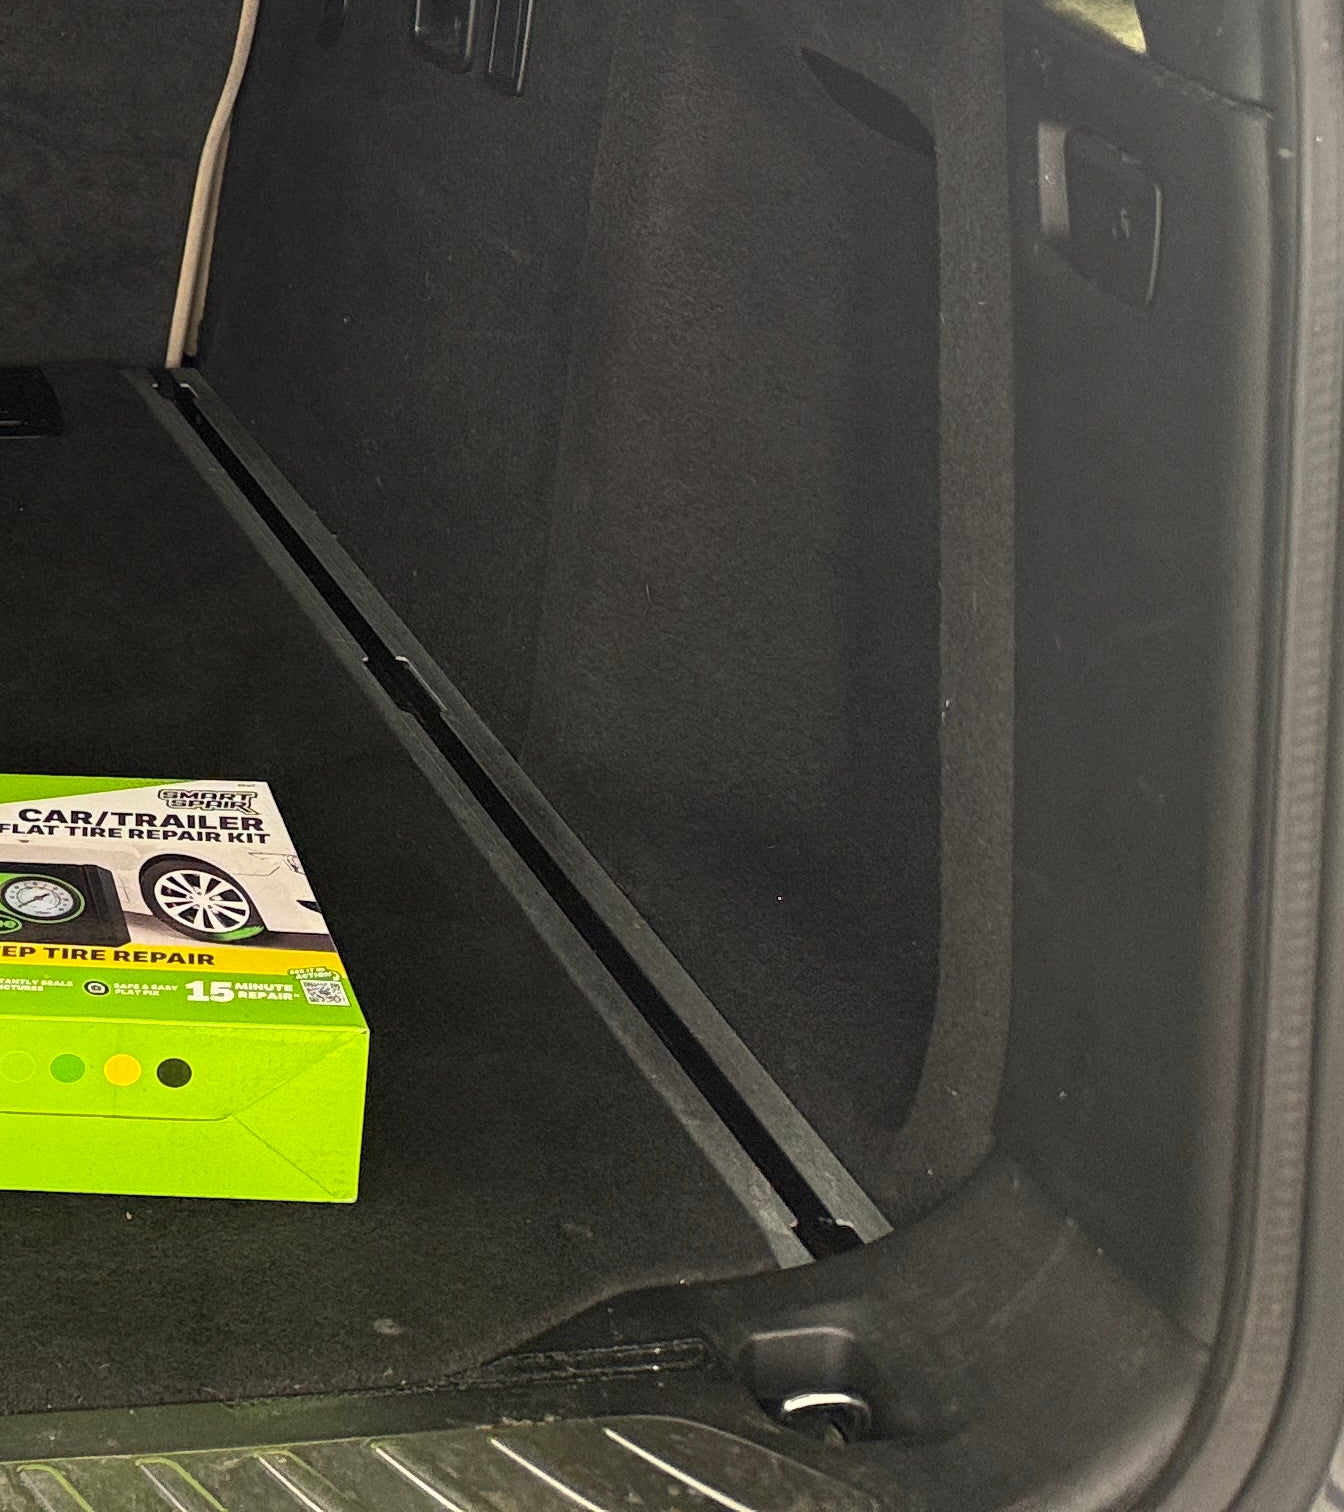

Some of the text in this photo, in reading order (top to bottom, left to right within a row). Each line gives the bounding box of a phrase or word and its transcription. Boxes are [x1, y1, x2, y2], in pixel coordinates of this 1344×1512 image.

[160, 790, 257, 801] SMART
[169, 799, 258, 814] SPAIR
[19, 808, 263, 831] CAR/TRAILER
[64, 825, 122, 839] TIRE
[129, 828, 222, 843] REPAIR
[228, 831, 270, 844] KIT
[44, 947, 106, 961] TIRE
[113, 949, 215, 966] REPAIR
[295, 971, 332, 979] ACTION
[185, 980, 234, 1002] 15
[235, 982, 293, 992] MINUTE
[238, 991, 293, 1001] REPAIR
